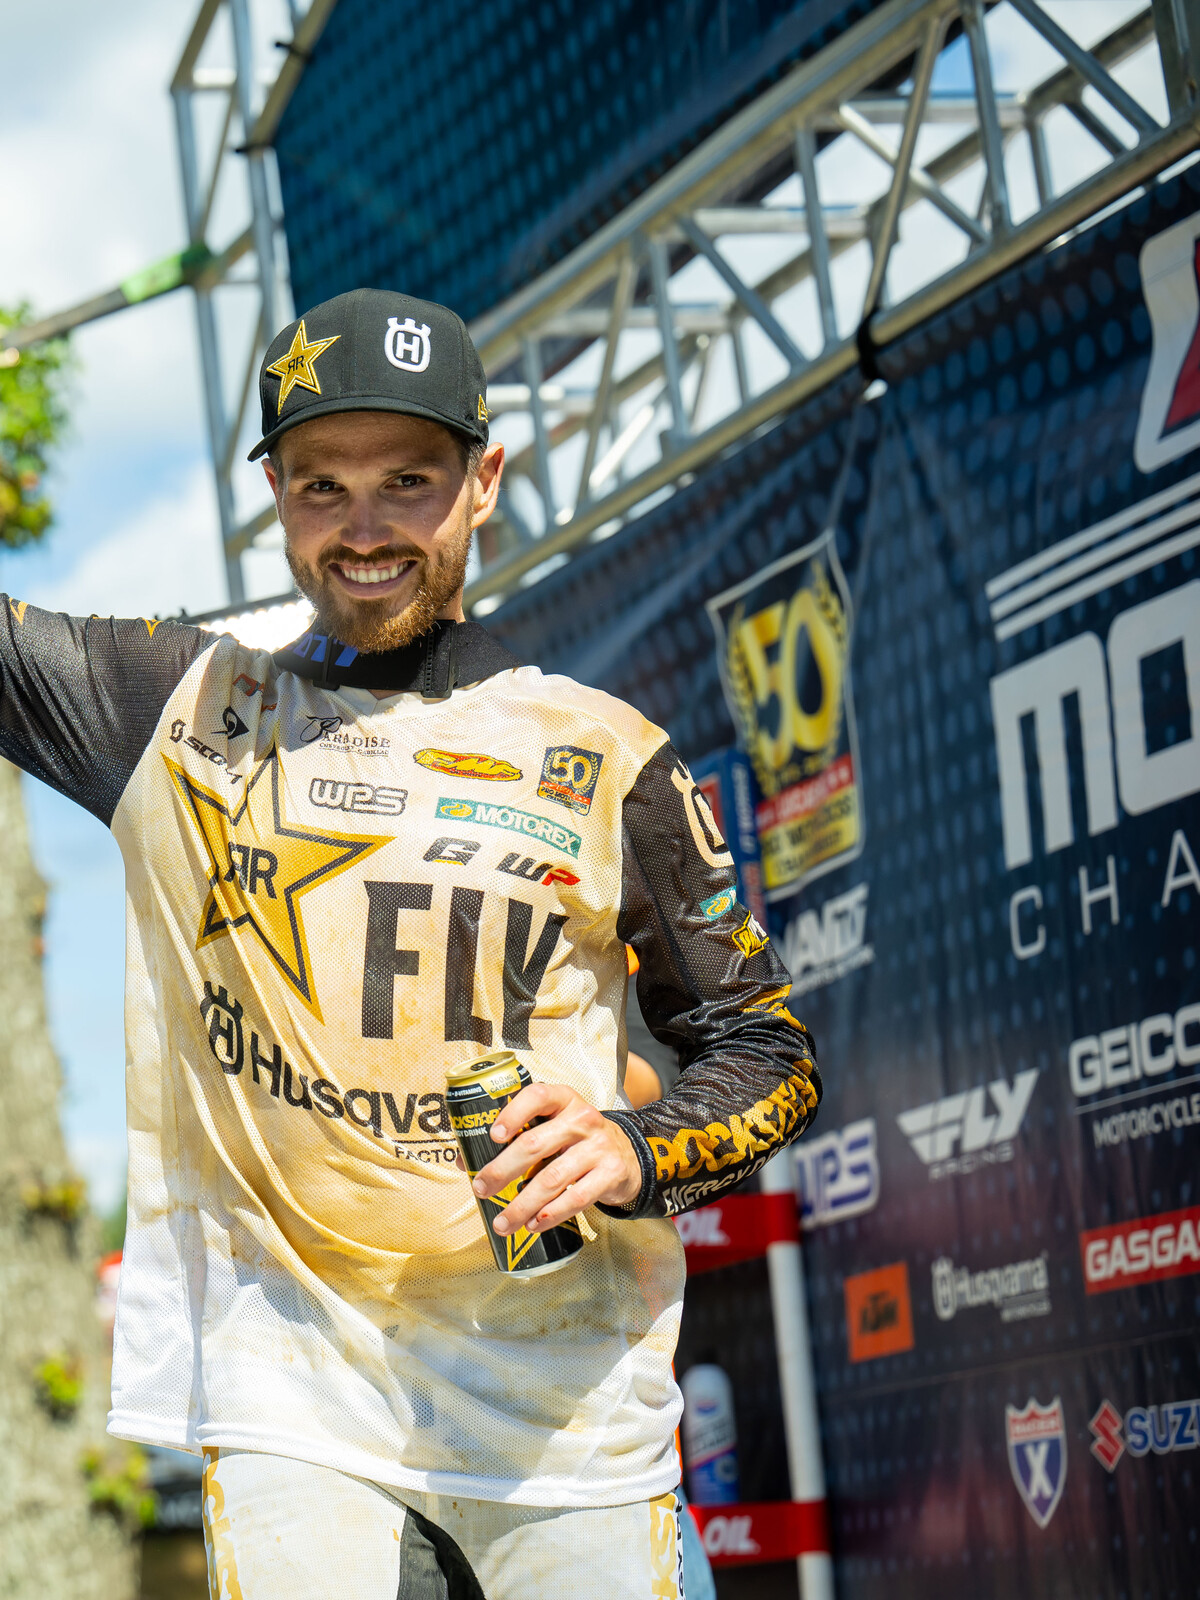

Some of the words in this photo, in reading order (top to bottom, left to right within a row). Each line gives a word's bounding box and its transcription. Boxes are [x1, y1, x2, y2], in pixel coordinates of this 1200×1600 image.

[739, 588, 844, 767] 50
[183, 735, 243, 785] SCOT
[552, 750, 593, 789] 50
[308, 778, 408, 816] WPS
[475, 804, 577, 854] MOTOREX
[495, 851, 581, 887] WP
[361, 880, 571, 1052] FLY
[250, 1031, 453, 1138] Husqva
[490, 1079, 519, 1094] CAFFEINE
[463, 1126, 488, 1138] DRINK
[896, 1066, 1040, 1166] FLY
[394, 1146, 460, 1164] FACTO
[662, 1164, 752, 1218] ENERGY
[1085, 1217, 1200, 1284] GASGA
[1126, 1402, 1200, 1456] SUZ
[1023, 1441, 1055, 1499] X
[702, 1514, 757, 1557] OIL
